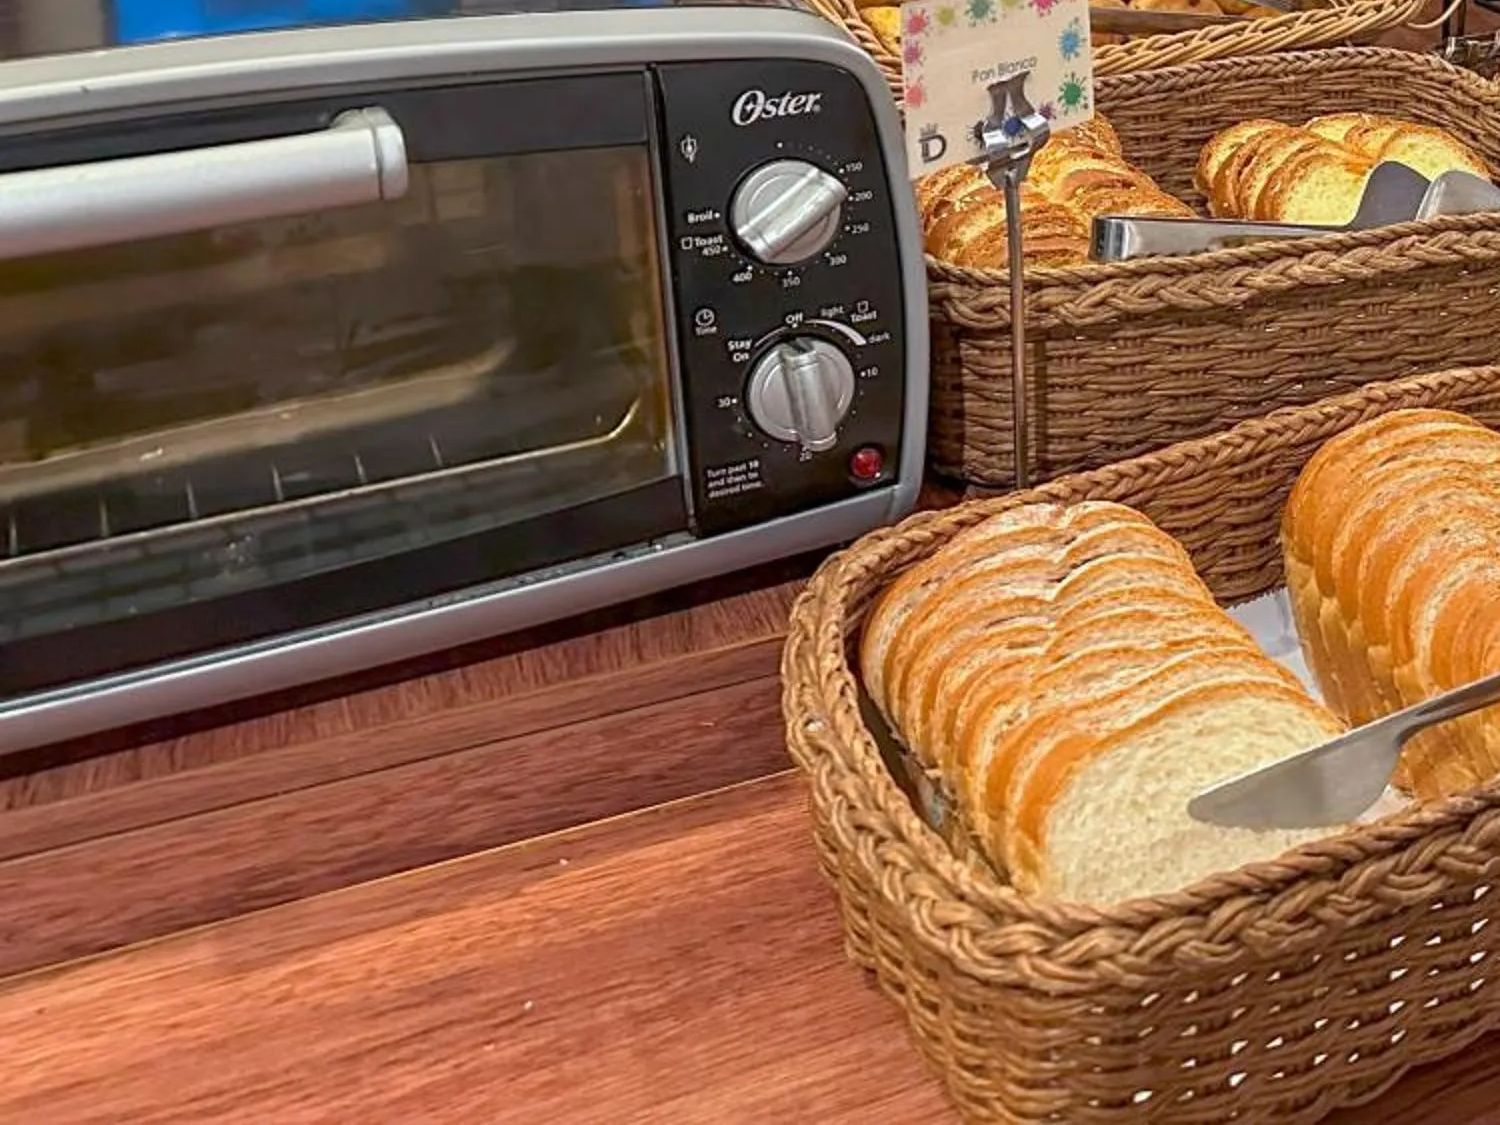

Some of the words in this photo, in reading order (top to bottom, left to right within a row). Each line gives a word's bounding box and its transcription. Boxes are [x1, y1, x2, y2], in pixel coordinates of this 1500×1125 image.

[972, 68, 996, 84] Pan
[997, 56, 1038, 77] Blanco
[731, 89, 823, 126] Oster
[855, 190, 874, 203] 200
[687, 209, 713, 224] Broil
[694, 234, 723, 247] Toast
[732, 270, 753, 283] 400
[785, 312, 804, 325] Off
[849, 310, 878, 324] Toast
[868, 331, 891, 345] dark
[727, 338, 753, 352] Stay
[732, 351, 750, 363] On
[866, 365, 879, 377] 10
[717, 397, 731, 408] 30
